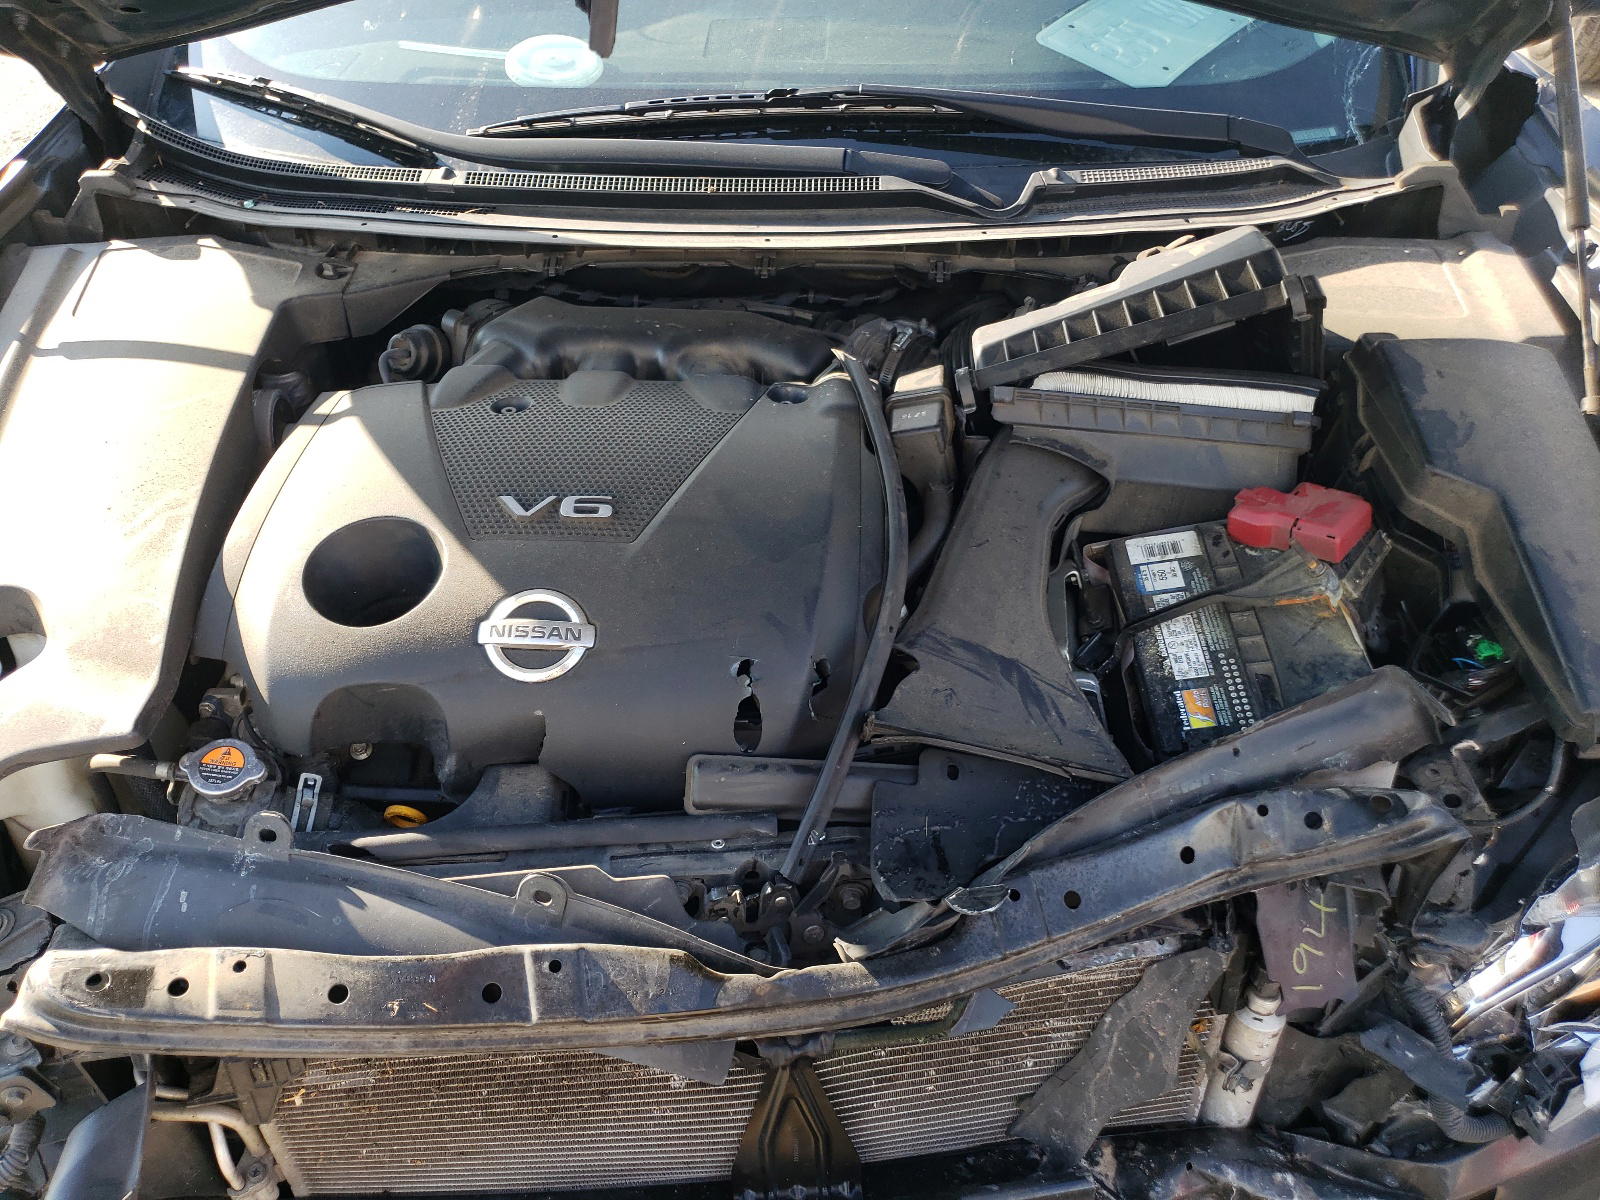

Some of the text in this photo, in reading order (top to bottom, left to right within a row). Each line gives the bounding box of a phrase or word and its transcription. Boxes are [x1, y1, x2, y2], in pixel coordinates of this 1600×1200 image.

[499, 495, 613, 518] V6
[489, 624, 582, 641] NISSAN
[1291, 893, 1338, 990] 194
